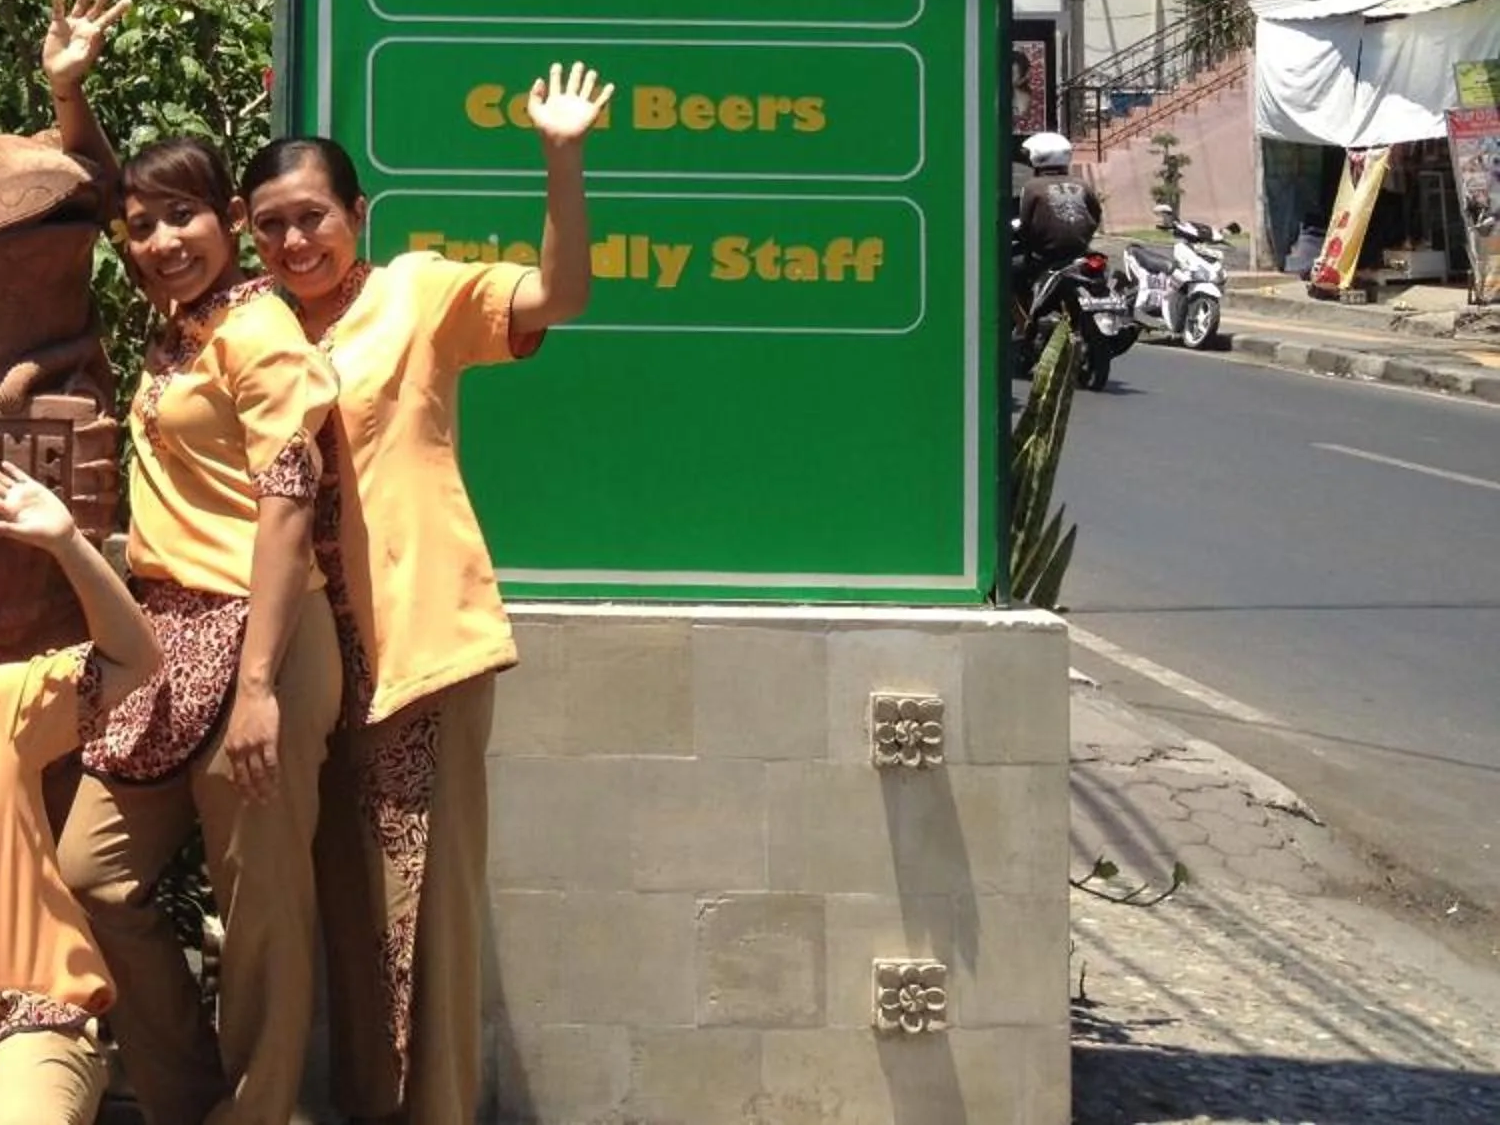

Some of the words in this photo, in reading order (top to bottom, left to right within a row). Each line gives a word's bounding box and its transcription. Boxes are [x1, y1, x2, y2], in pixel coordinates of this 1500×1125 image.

[632, 85, 826, 131] Beers
[409, 232, 692, 288] Friedly
[711, 236, 884, 281] Staff
